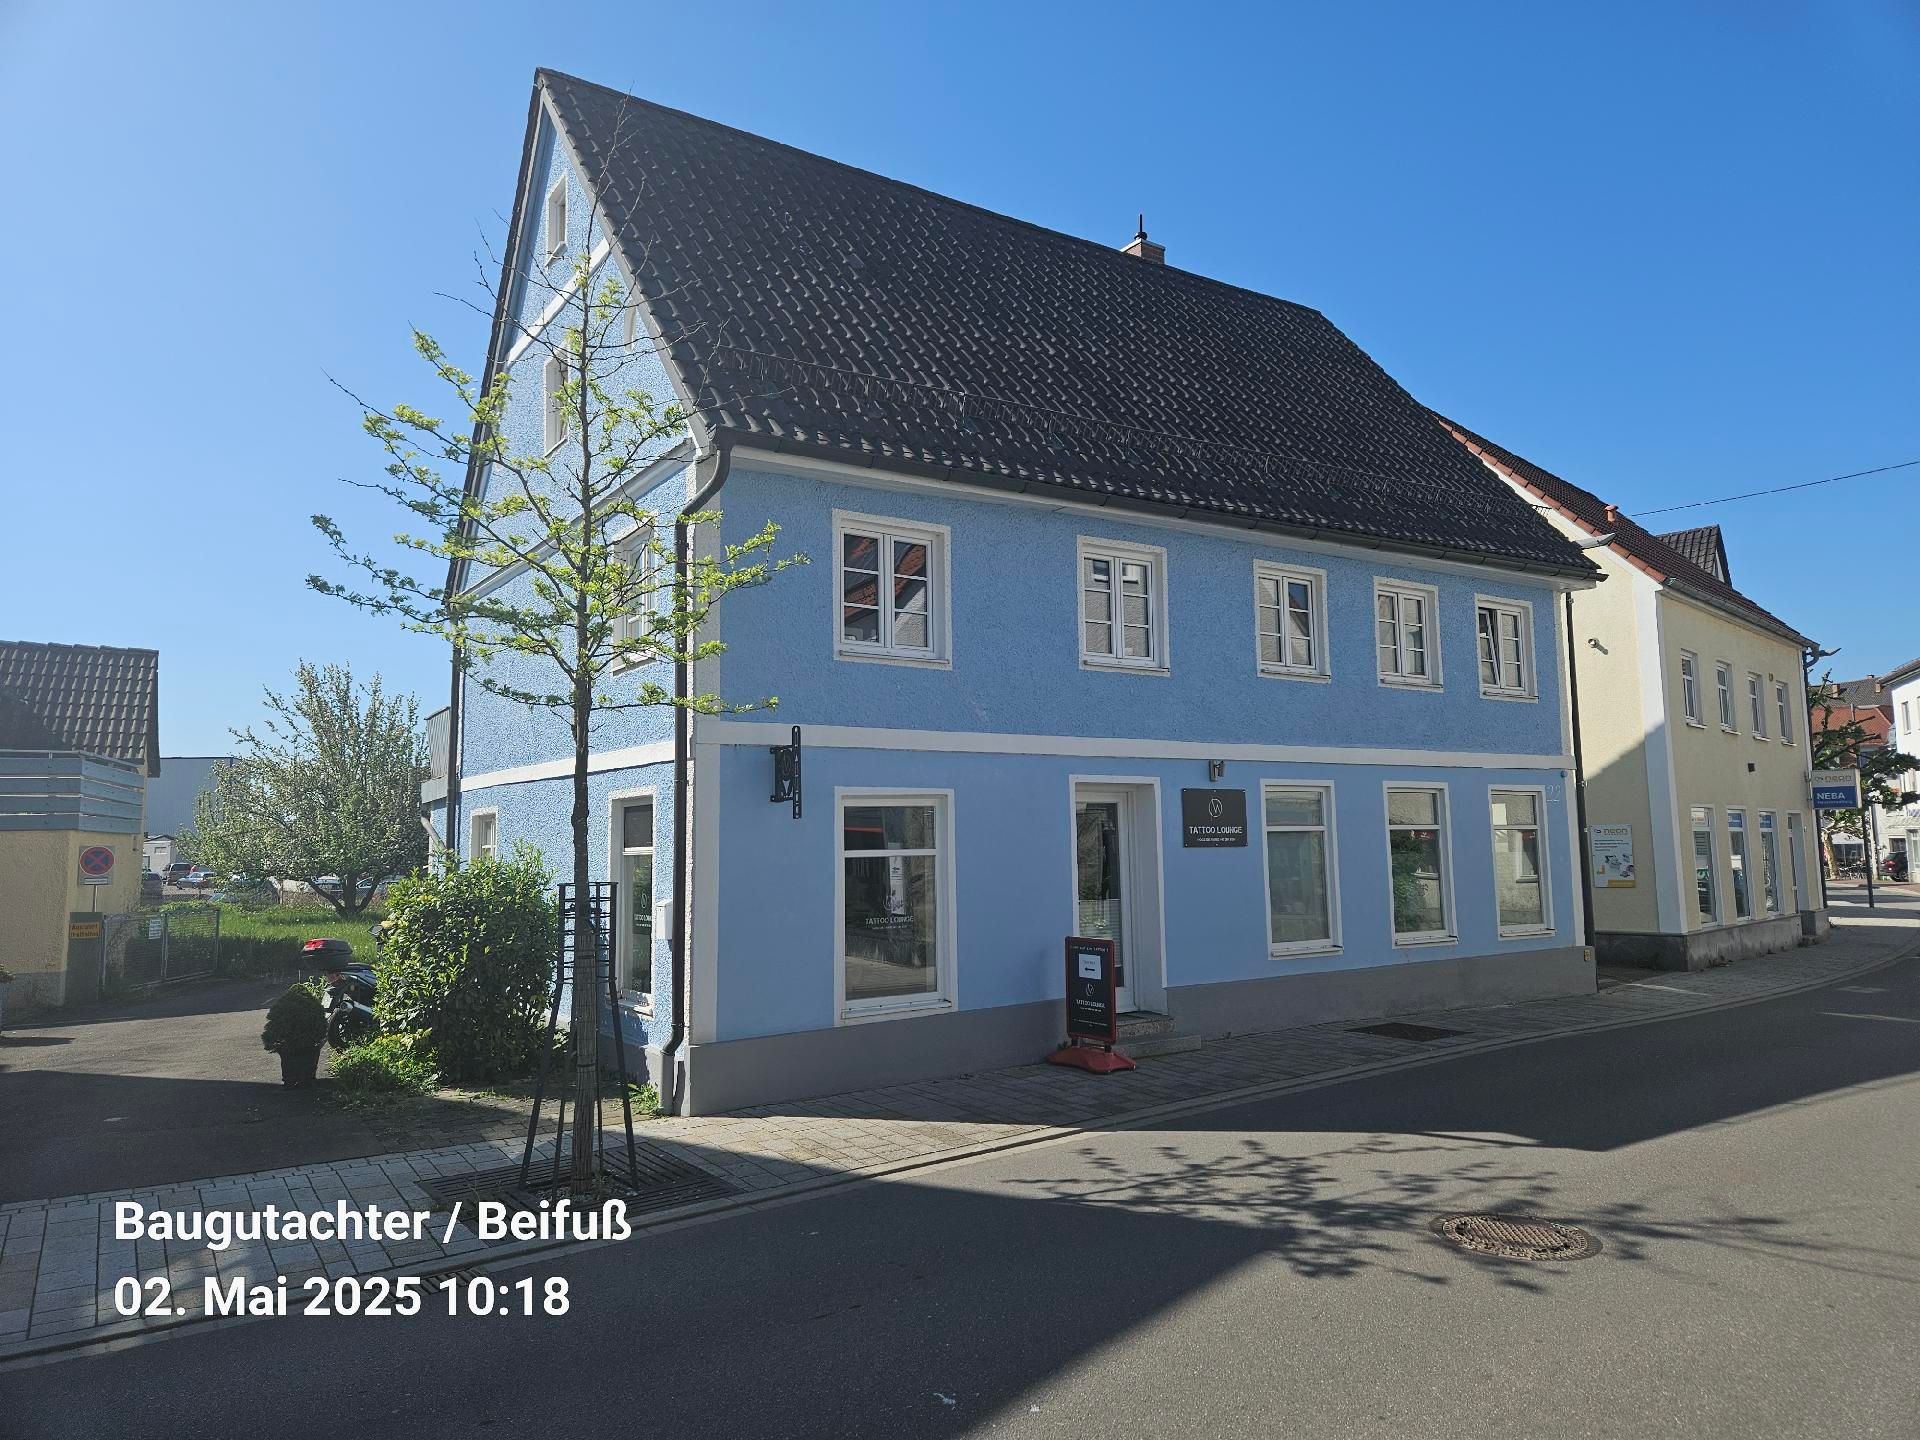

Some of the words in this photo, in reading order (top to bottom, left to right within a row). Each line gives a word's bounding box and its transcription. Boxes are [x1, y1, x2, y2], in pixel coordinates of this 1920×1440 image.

[1816, 792, 1846, 800] NEBA
[1189, 826, 1216, 834] TATTOO
[1216, 826, 1243, 834] LOUNGE
[865, 917, 889, 925] TATTOO
